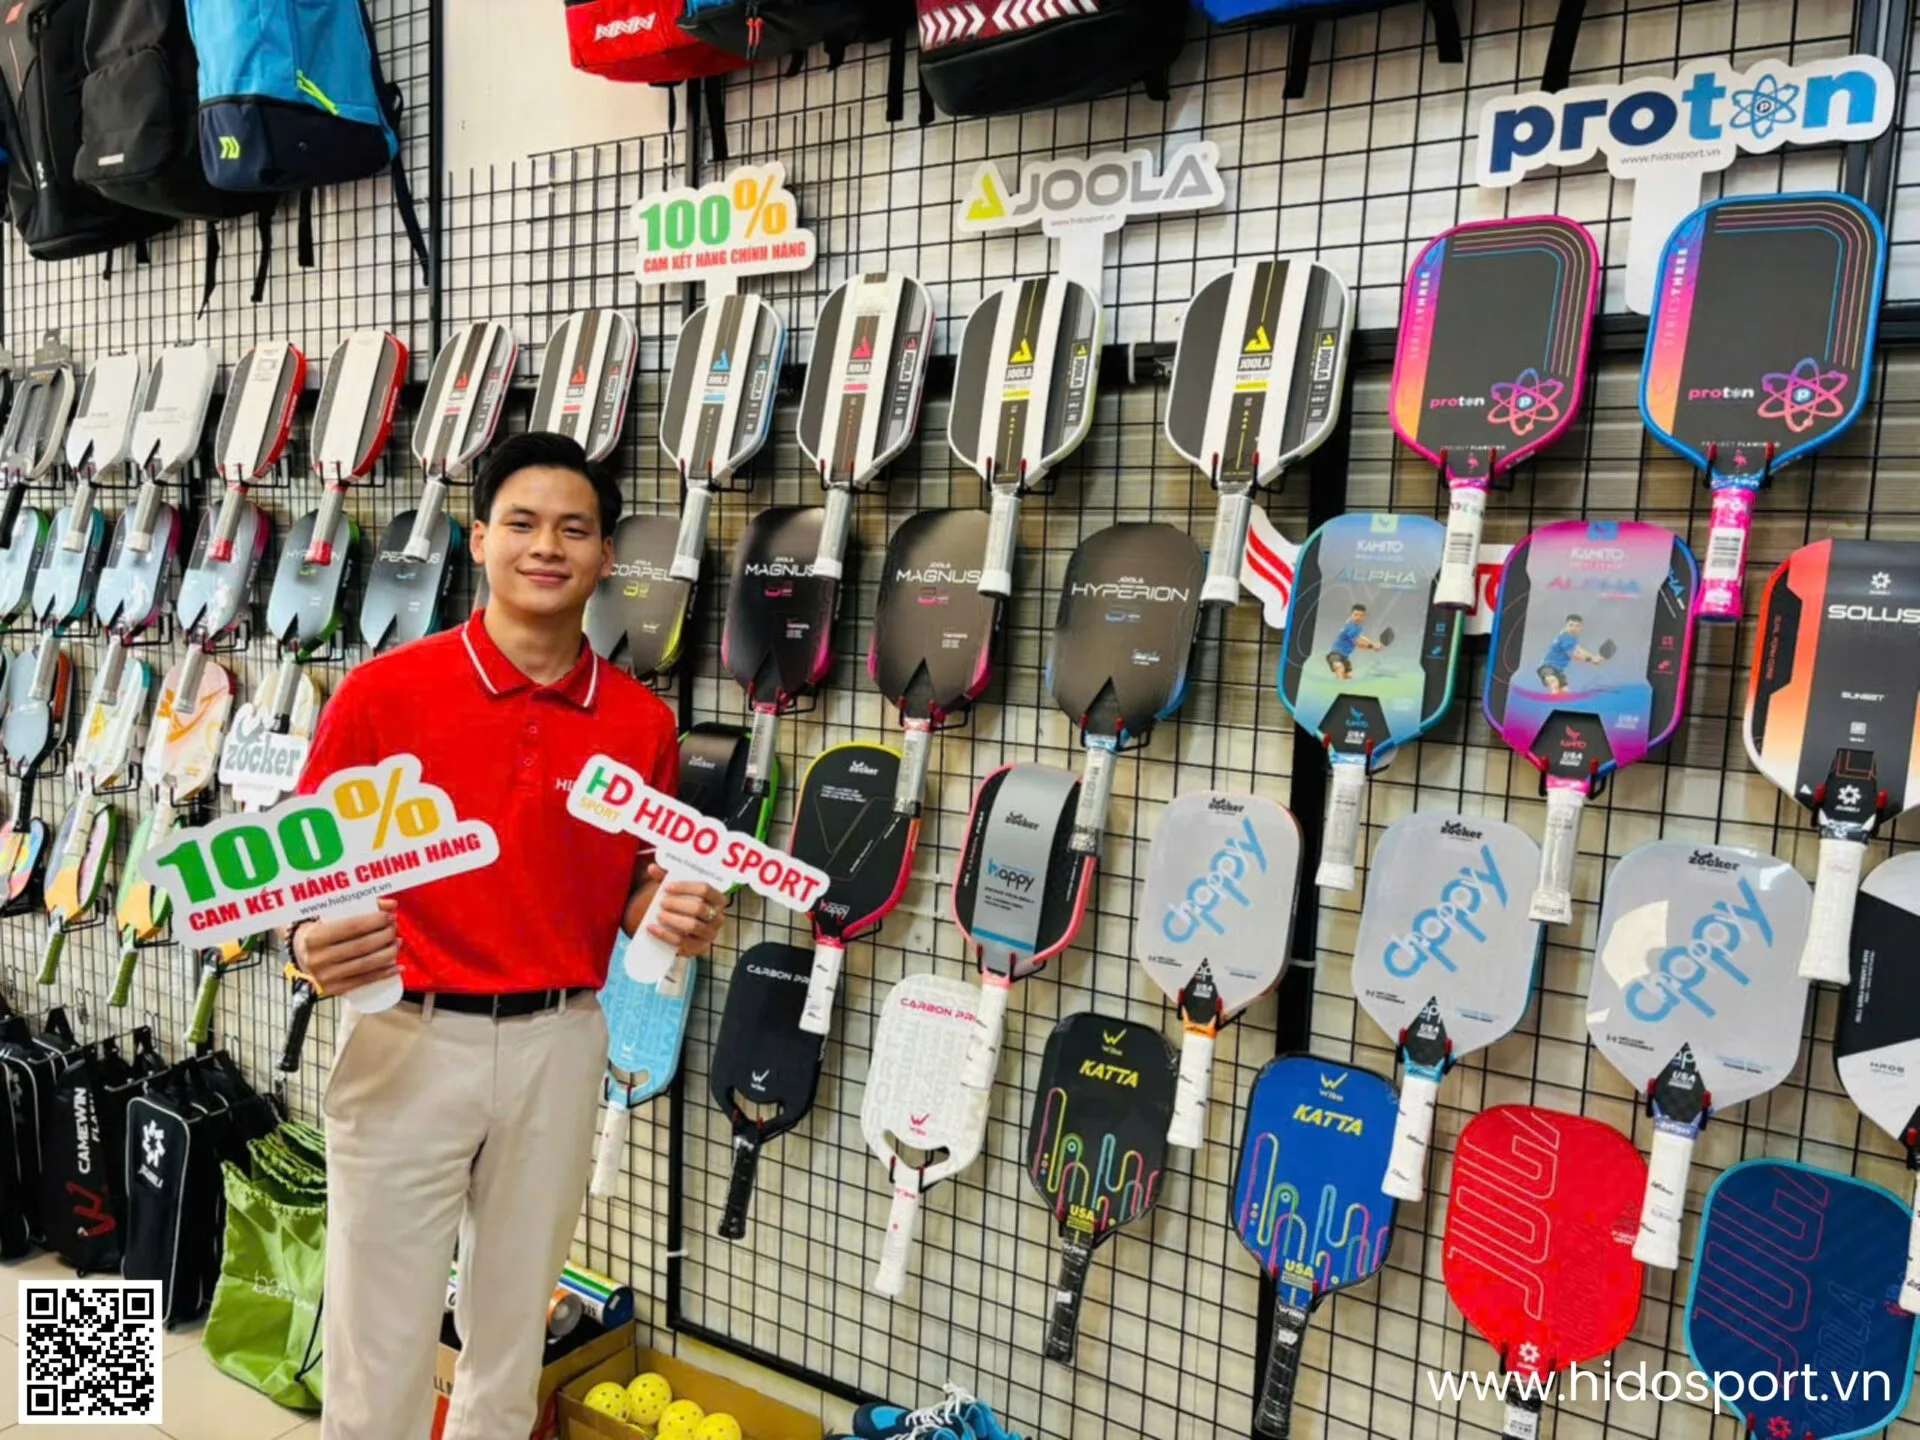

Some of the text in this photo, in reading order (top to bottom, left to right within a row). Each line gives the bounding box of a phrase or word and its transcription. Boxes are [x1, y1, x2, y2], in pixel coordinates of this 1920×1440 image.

[1620, 147, 1721, 167] www.hidosport.vn
[1012, 153, 1212, 216] JOOLA
[638, 174, 787, 252] 100%
[643, 255, 669, 273] CAM
[671, 251, 692, 271] KẾT
[1356, 540, 1404, 552] KAMITO
[1571, 548, 1625, 560] KAMITO
[745, 563, 816, 577] MAGNUS
[896, 569, 982, 584] MAGNUS
[1337, 566, 1417, 584] ALPHA
[1071, 582, 1190, 603] HYPERION
[578, 796, 622, 824] SPORT
[156, 766, 440, 905] 100%
[633, 797, 718, 855] HIDO
[721, 841, 821, 903] SPORT
[1689, 850, 1740, 871] zocker
[189, 901, 241, 932] CAM
[248, 887, 285, 916] KẾT
[290, 871, 350, 903] HÀNG
[354, 849, 421, 884] CHÍNH
[300, 881, 393, 916] www.hidosport.vn
[746, 964, 792, 981] CARBON
[900, 997, 952, 1018] CARBON
[1079, 1059, 1139, 1088] KATTA
[1672, 1071, 1696, 1084] USA
[73, 1087, 91, 1174] CAMEWIN
[1292, 1104, 1363, 1136] KATTA
[1070, 1203, 1095, 1221] USA
[1284, 1259, 1314, 1279] USA
